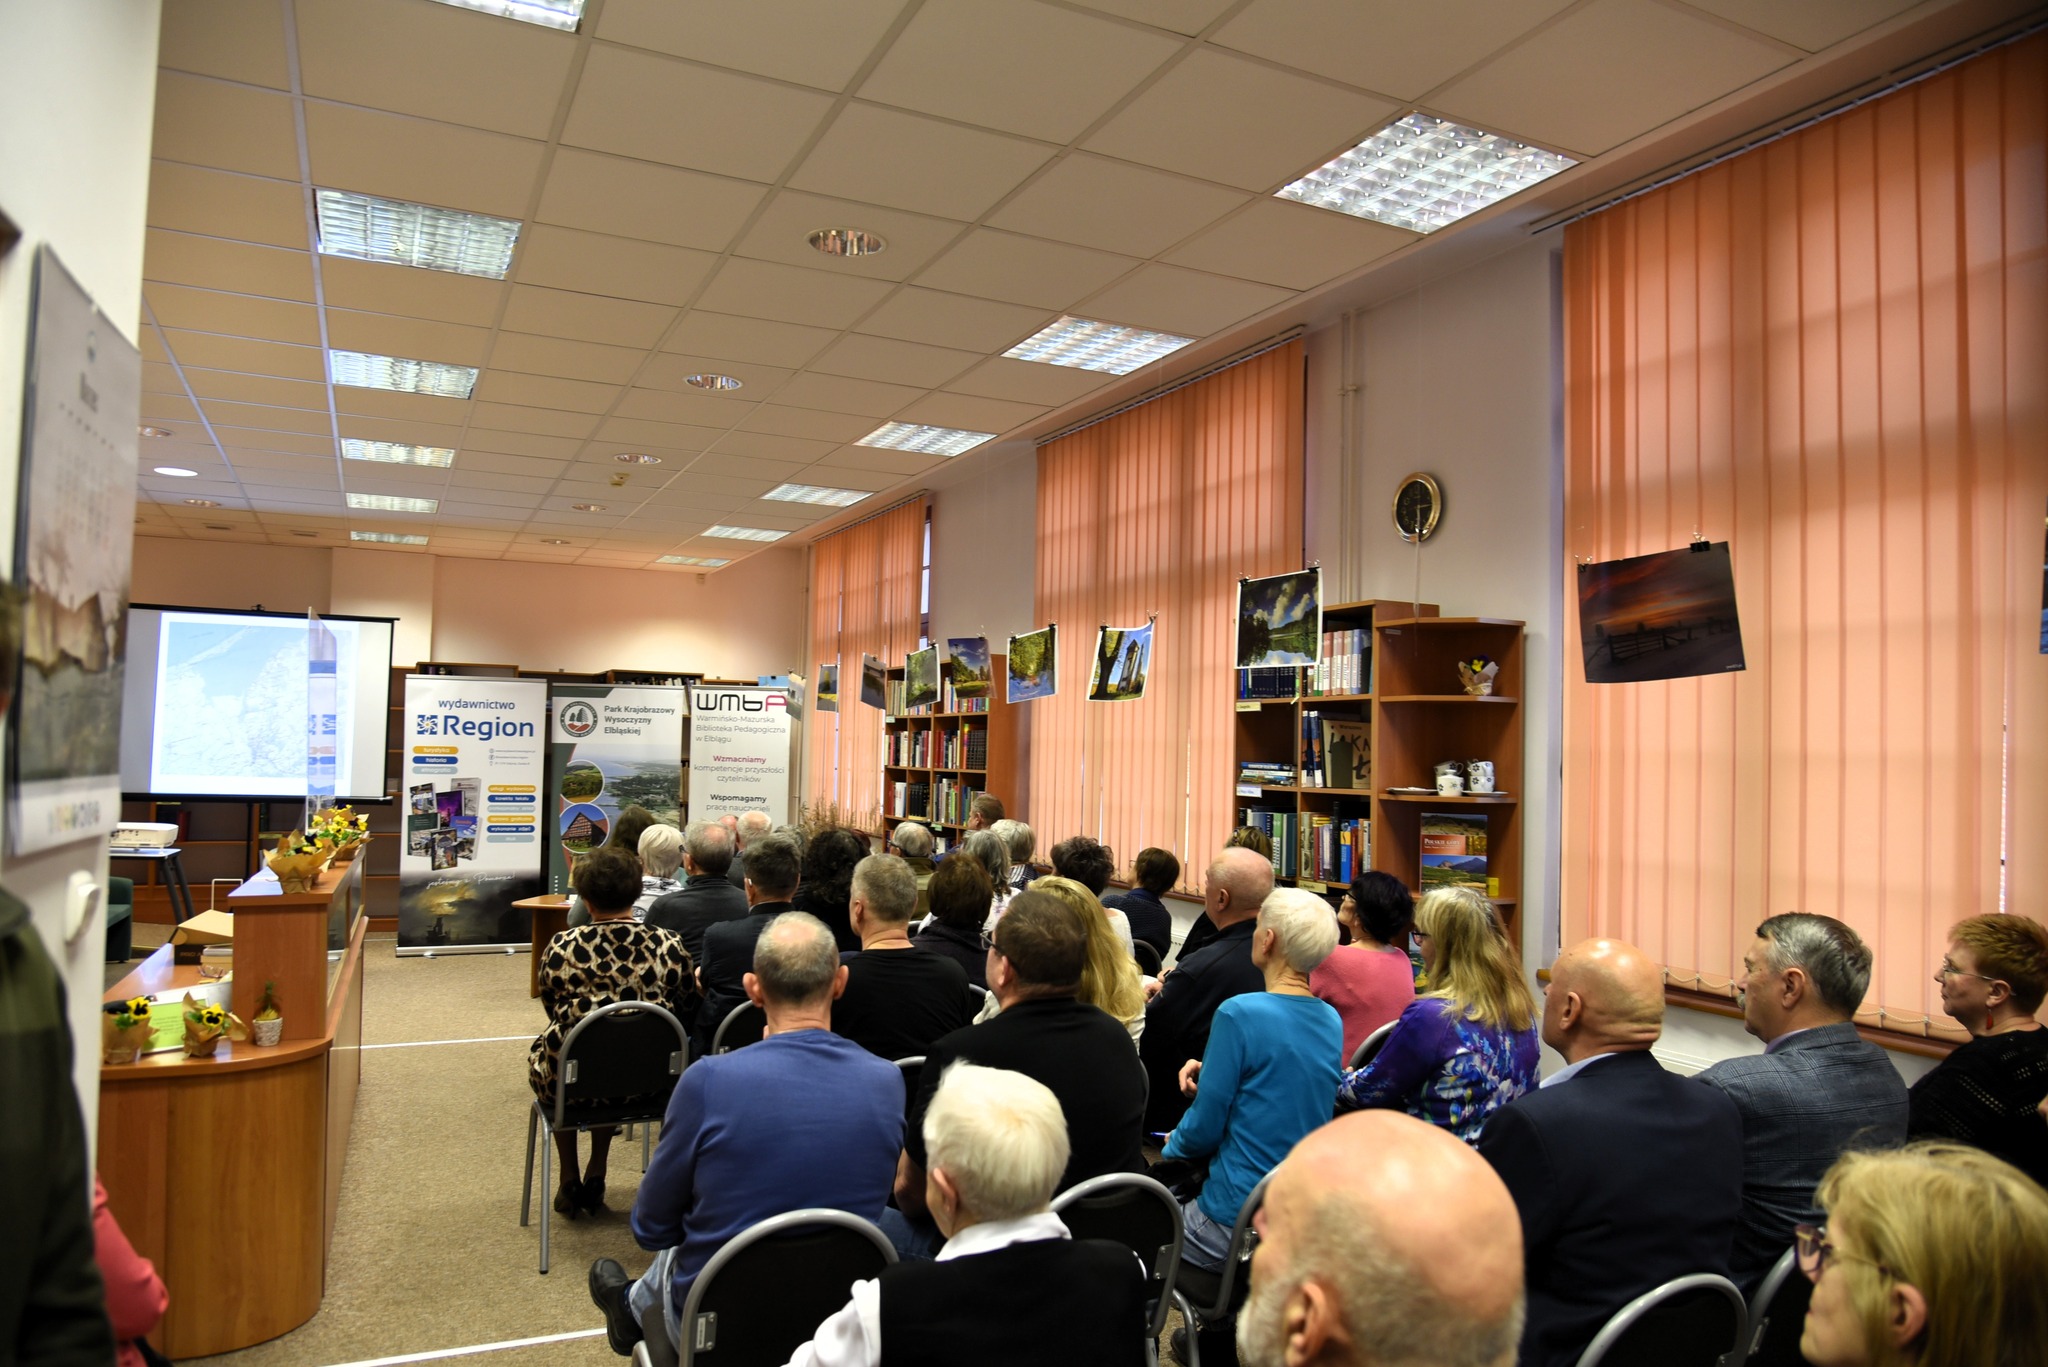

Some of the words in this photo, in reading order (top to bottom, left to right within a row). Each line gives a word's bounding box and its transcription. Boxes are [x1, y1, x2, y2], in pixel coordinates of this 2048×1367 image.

[438, 698, 515, 710] wydawnictwo
[604, 705, 622, 713] Park
[624, 706, 675, 715] Krajobrazowy
[604, 716, 652, 725] Wysoczyzny
[696, 715, 775, 723] Warmińsko-Mazurska
[443, 715, 535, 741] Region
[604, 727, 641, 736] Elbląskiej
[734, 726, 786, 734] Pedagogiczna
[704, 736, 732, 744] Elblągu
[713, 755, 766, 764] Wzmacniamy
[694, 764, 743, 774] kompetencje
[745, 766, 785, 774] przyszłości
[717, 775, 761, 783] czytelników
[710, 793, 767, 803] Wspomagamy
[706, 804, 727, 812] pracę
